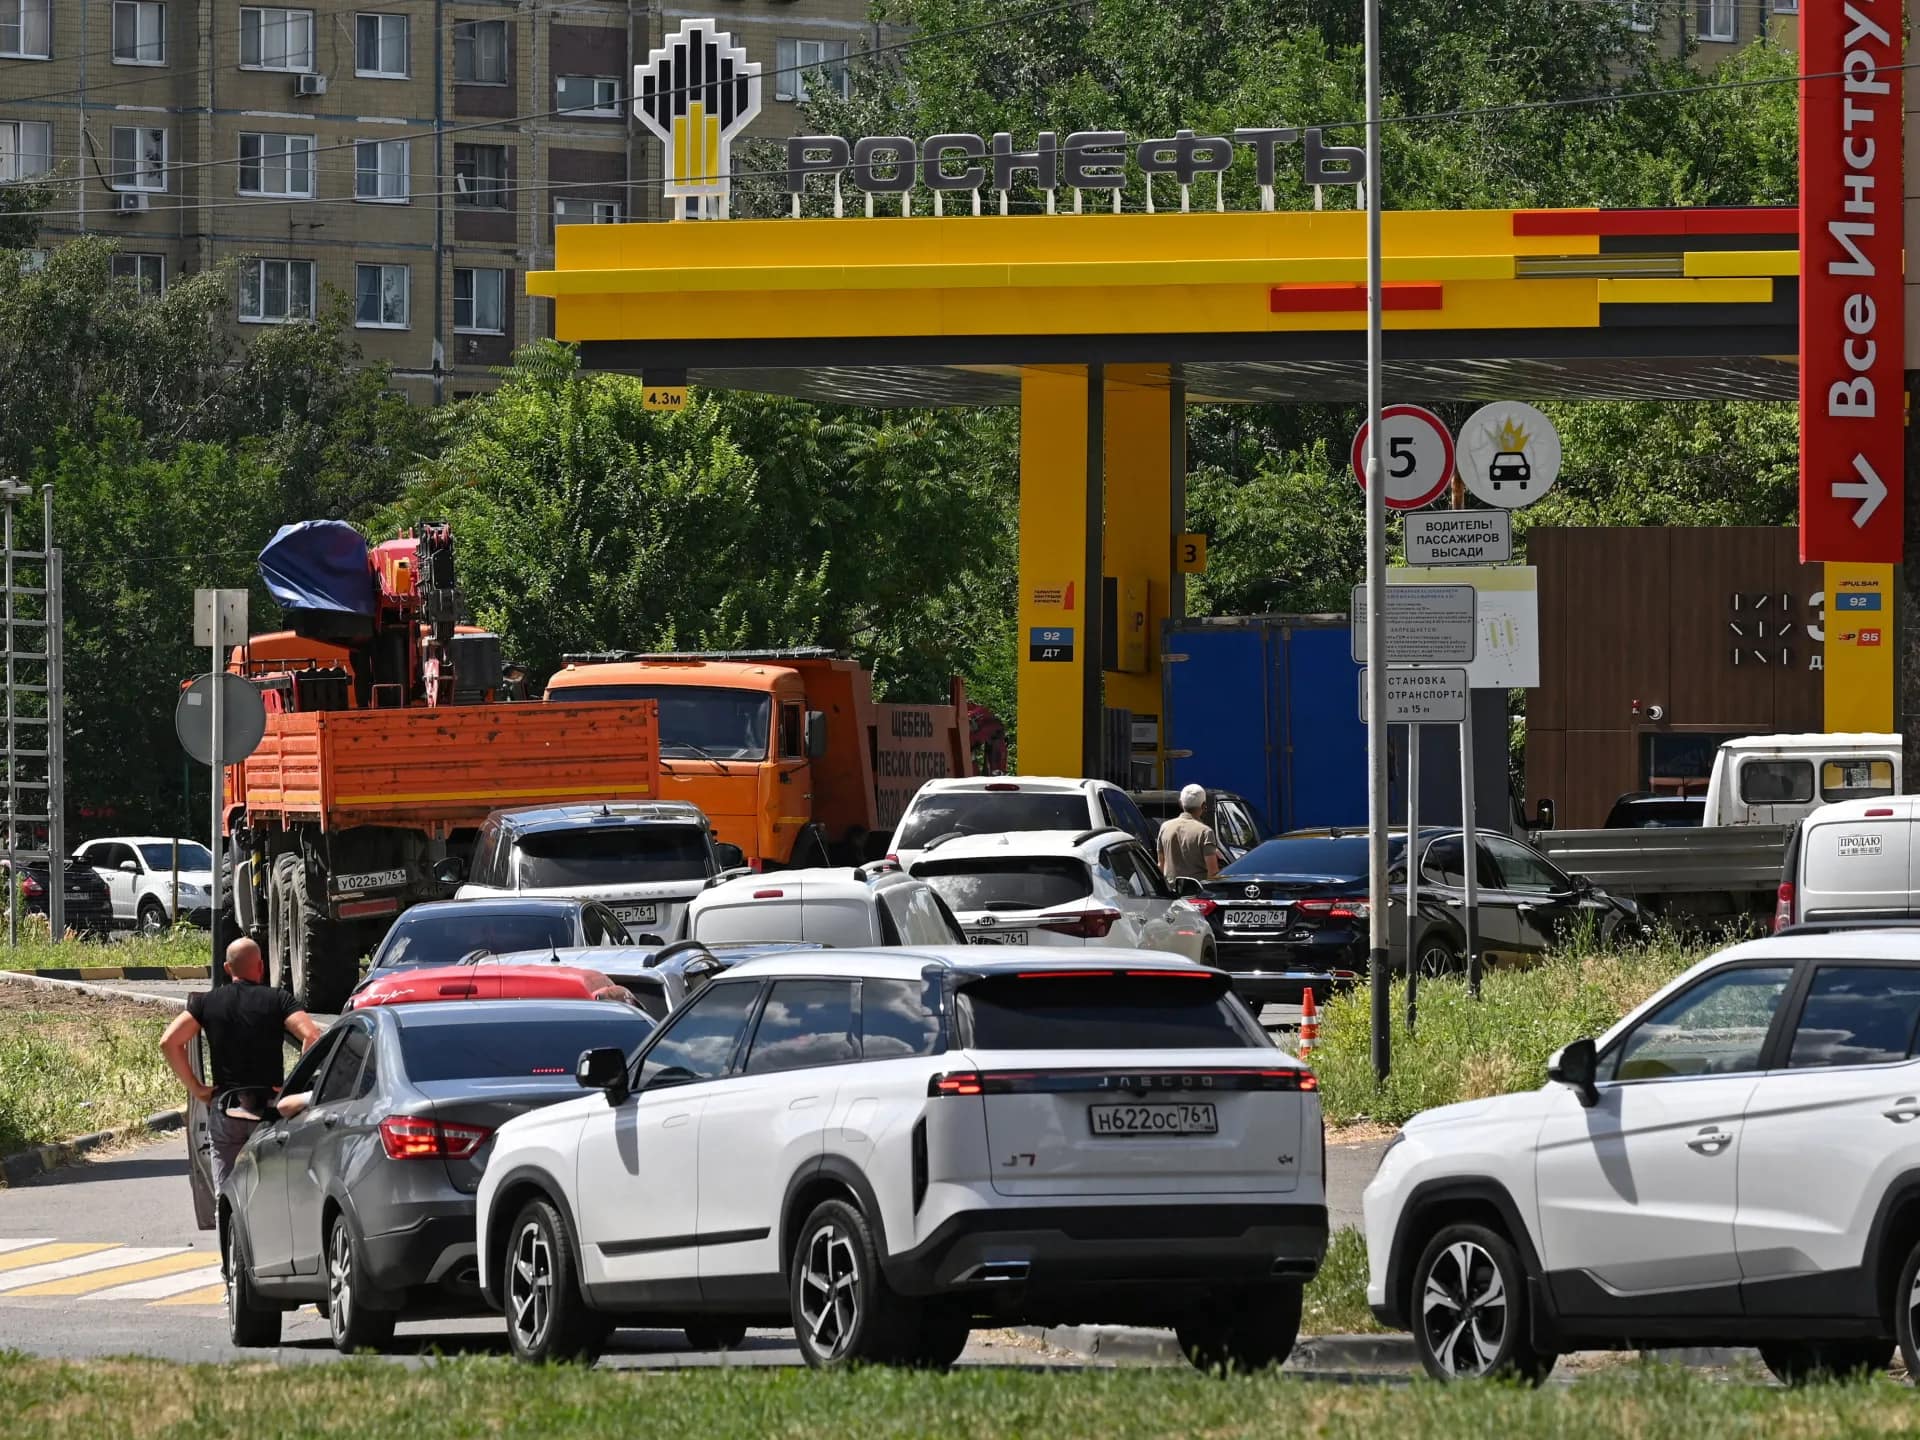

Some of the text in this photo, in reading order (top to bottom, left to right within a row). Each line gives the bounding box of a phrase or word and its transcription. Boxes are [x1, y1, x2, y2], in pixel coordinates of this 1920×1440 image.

[786, 128, 1366, 194] РОСНЕФТЬ
[1828, 0, 1890, 418] Все Инстру
[1390, 437, 1417, 478] 5
[1425, 519, 1493, 533] ВОДИТЕЛЬ!
[1416, 533, 1500, 546] ПАССАЖИРОВ
[1183, 544, 1197, 563] 3
[1431, 547, 1484, 558] ВЫСАДИ
[1849, 597, 1867, 607] 92
[1043, 631, 1060, 641] 92
[1862, 632, 1879, 642] 95
[1042, 648, 1060, 658] ДТ
[1388, 676, 1447, 686] СТАНОВКА
[1387, 690, 1464, 700] ОТРАНСПОРТА
[1412, 704, 1421, 714] 15
[891, 711, 934, 741] ЩЕБЕНЬ
[878, 751, 912, 777] ПЕСОК
[1840, 836, 1881, 847] ПРОДАЮ
[633, 907, 653, 917] 761
[1226, 911, 1285, 924] В022ОВ 761
[1004, 933, 1023, 944] 761
[1098, 1106, 1212, 1131] Н622ОС 761
[1001, 1153, 1036, 1167] J7
